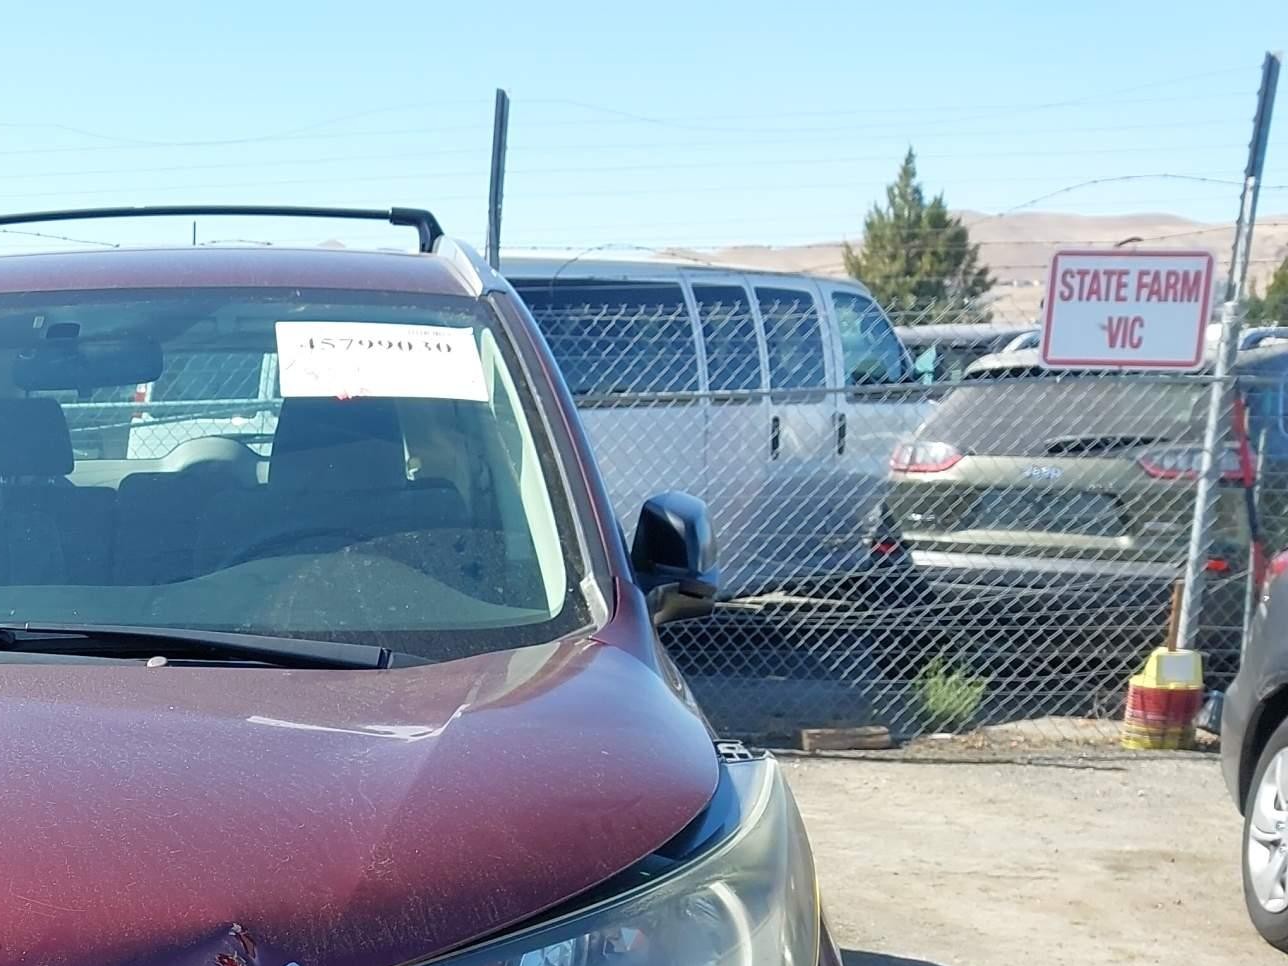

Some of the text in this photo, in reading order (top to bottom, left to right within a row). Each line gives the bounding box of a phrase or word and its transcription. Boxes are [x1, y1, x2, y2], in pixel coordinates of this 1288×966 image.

[1059, 269, 1202, 303] STATE FARM
[1106, 315, 1144, 349] VIC
